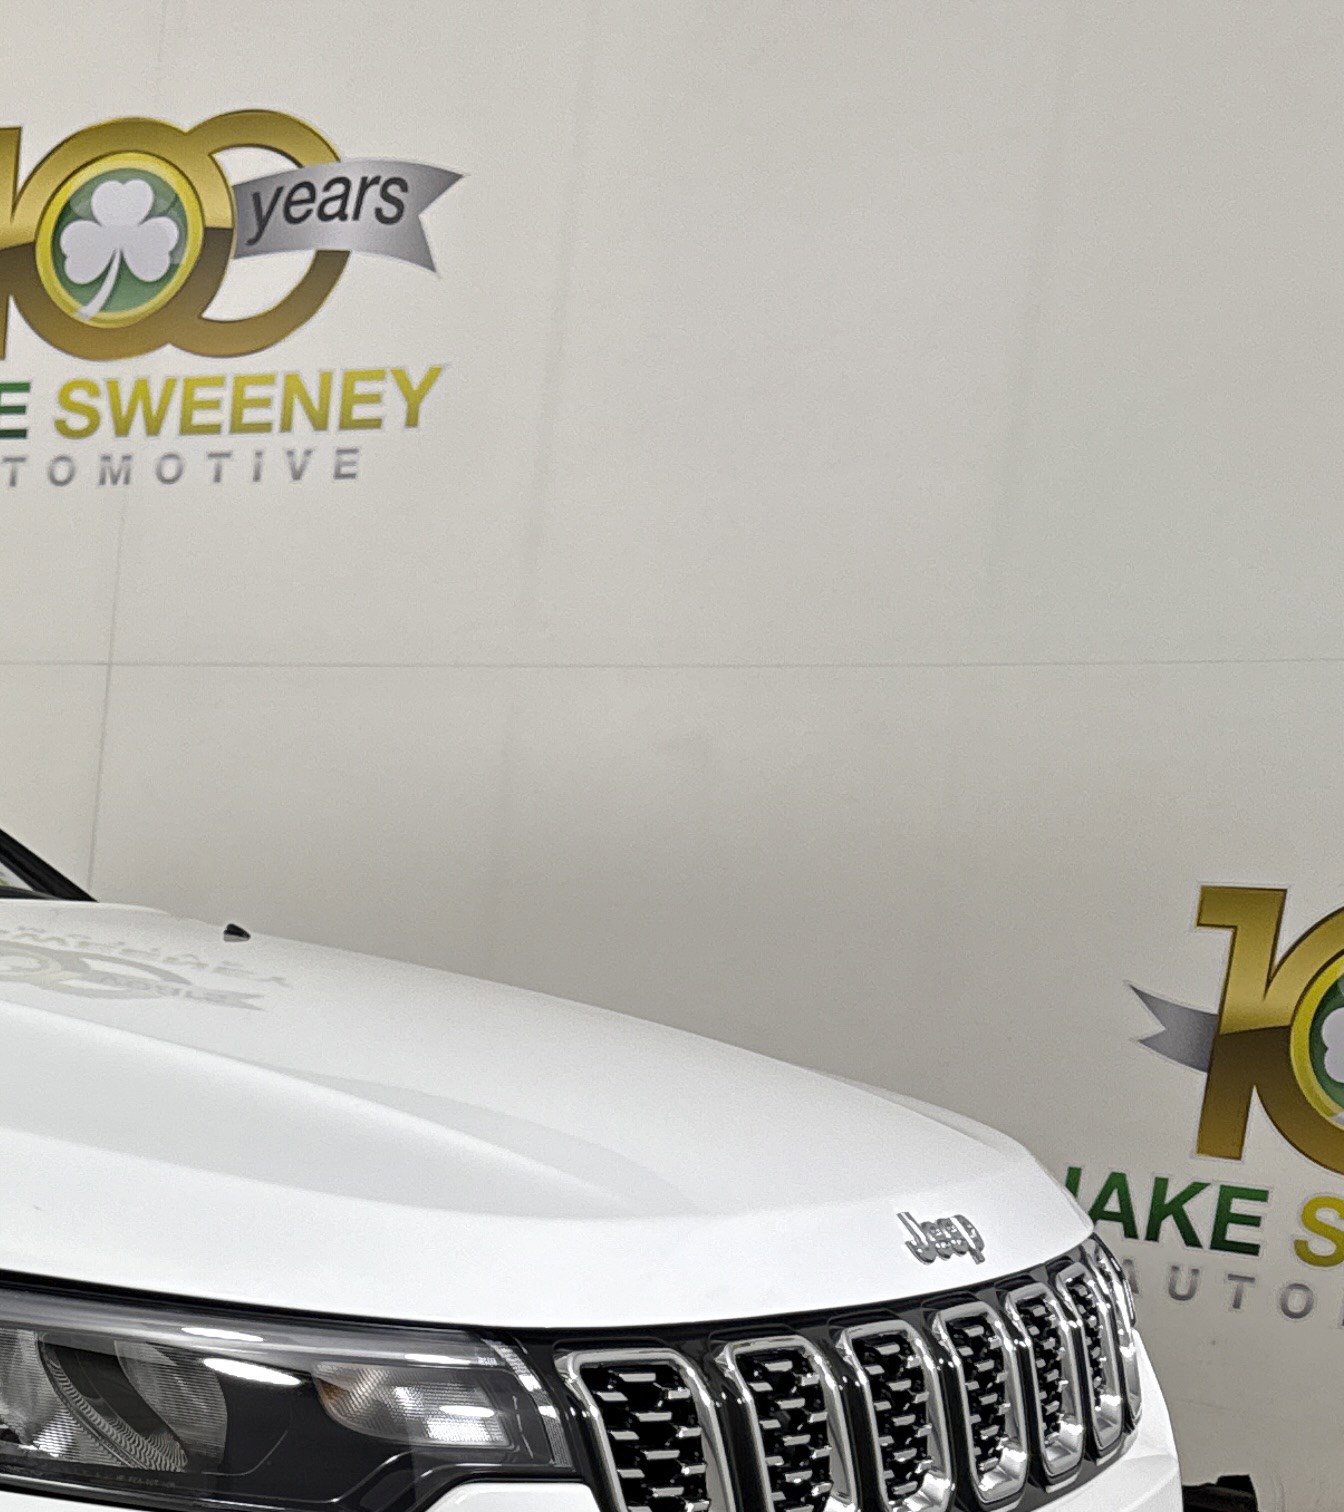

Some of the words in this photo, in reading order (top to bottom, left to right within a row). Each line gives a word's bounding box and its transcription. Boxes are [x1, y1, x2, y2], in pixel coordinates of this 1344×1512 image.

[246, 173, 410, 246] years
[53, 365, 444, 439] SWEENEY
[896, 1211, 986, 1265] Jeep
